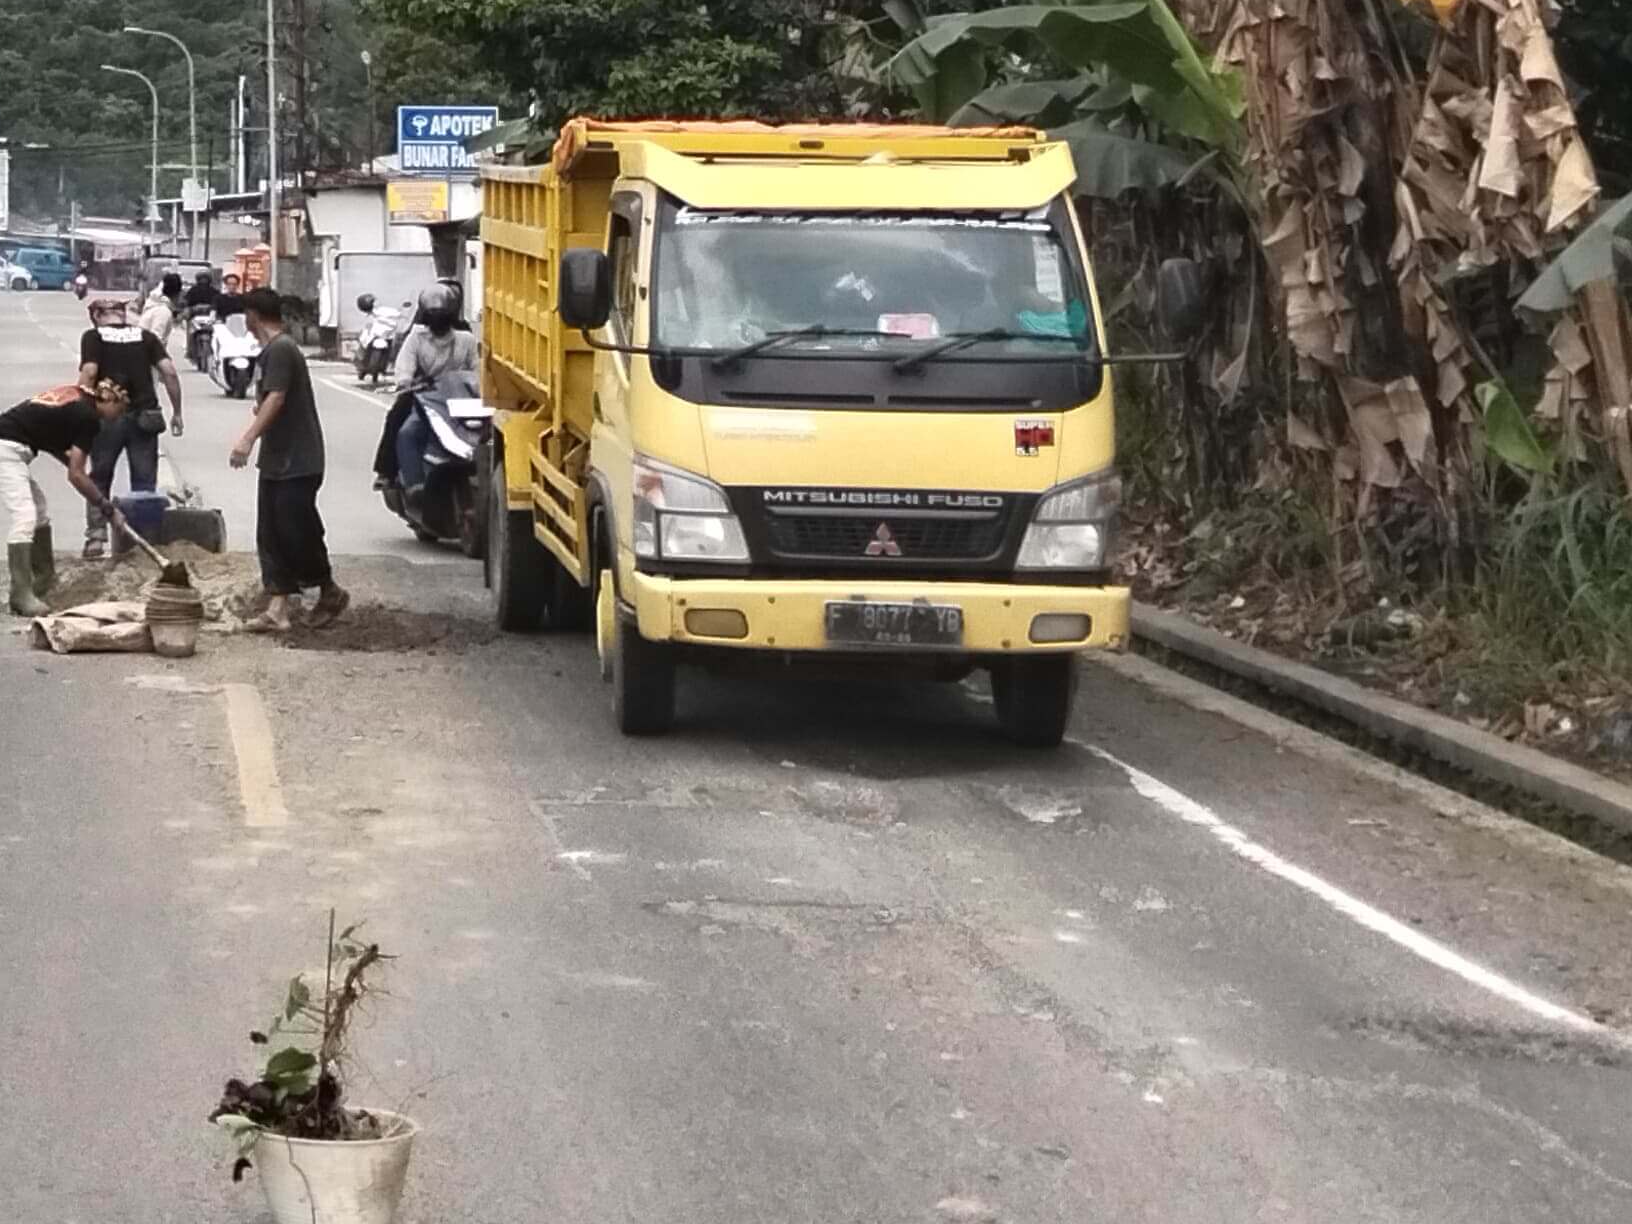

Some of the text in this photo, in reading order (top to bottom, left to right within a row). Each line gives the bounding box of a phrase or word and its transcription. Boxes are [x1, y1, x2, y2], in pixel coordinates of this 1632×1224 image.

[429, 114, 494, 136] APOTEK
[403, 144, 448, 167] BUNAR
[763, 490, 1003, 507] MITSUBISHI FUSO
